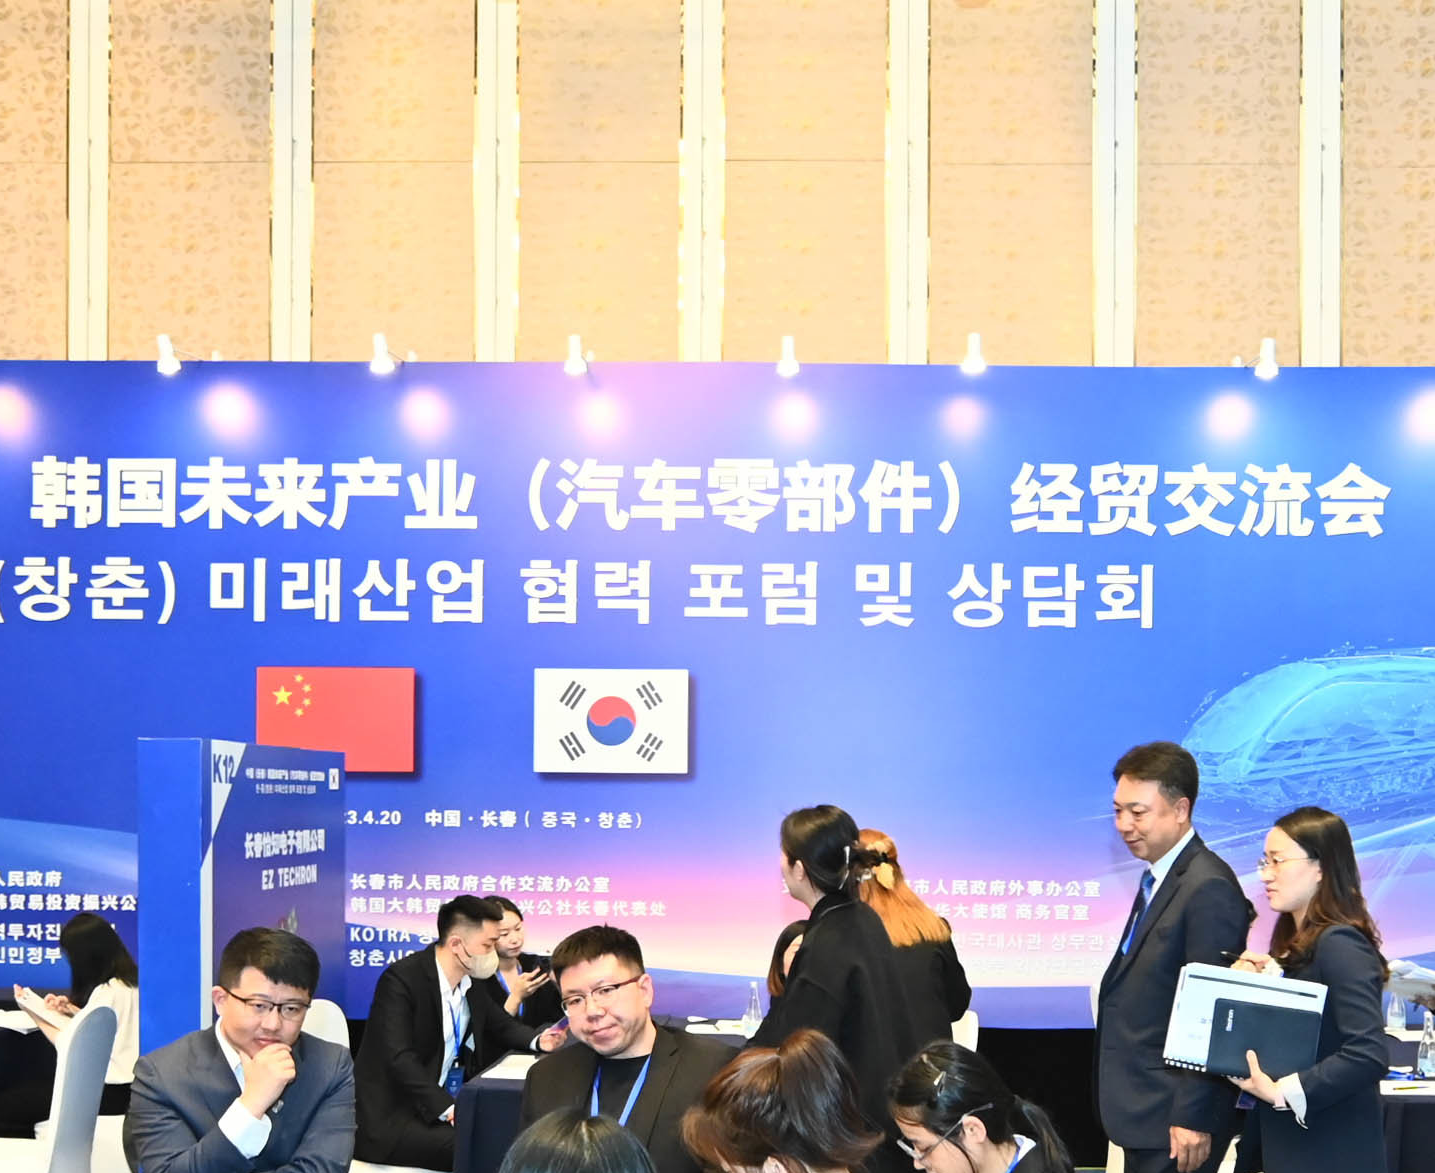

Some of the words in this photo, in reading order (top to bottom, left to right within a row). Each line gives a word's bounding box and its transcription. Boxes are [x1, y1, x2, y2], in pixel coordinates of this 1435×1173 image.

[208, 556, 484, 624] 미래산업
[519, 558, 652, 626] 협력
[683, 560, 819, 627] 포럼
[854, 562, 915, 629] 및
[947, 561, 1156, 630] 상담회
[212, 753, 235, 785] K12
[344, 810, 402, 826] 3.4.20
[261, 868, 275, 891] EZ
[277, 863, 318, 888] TECHRON
[350, 874, 610, 893] 长春市人民政府合作交流办公室
[350, 897, 667, 916] 韩国大韩贸兴公社长春代表处
[349, 927, 411, 943] KOTRA
